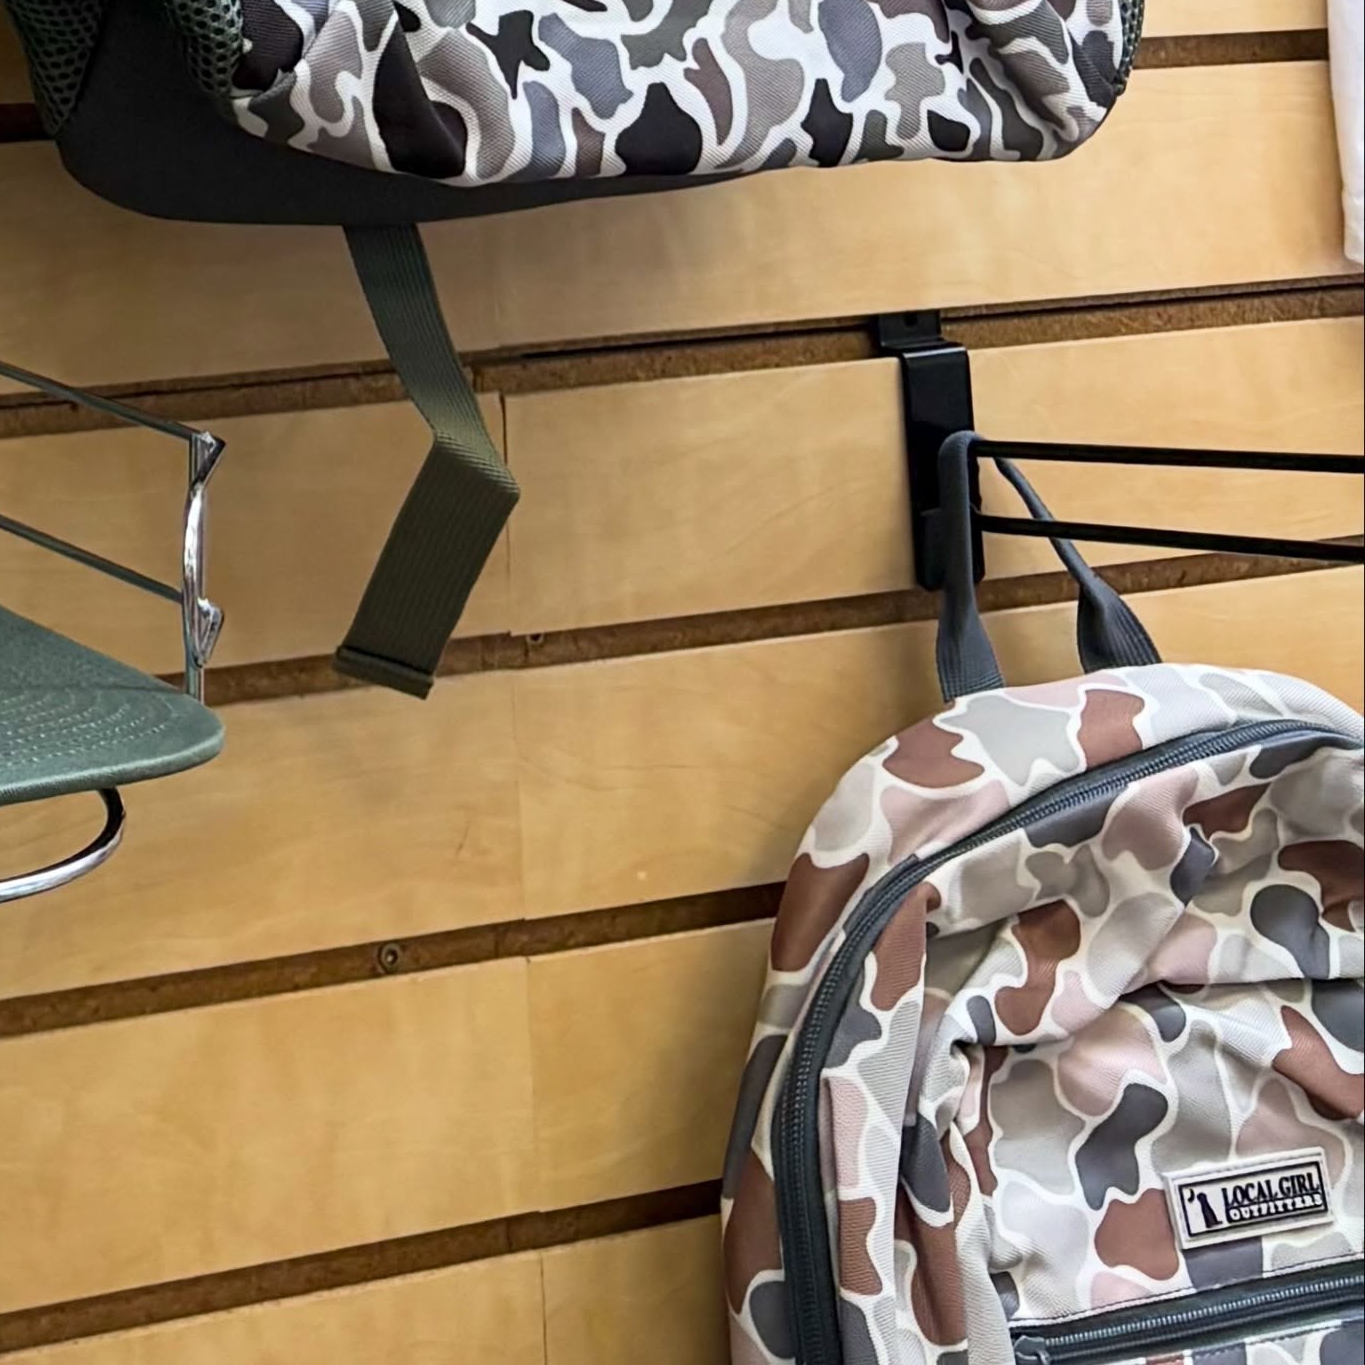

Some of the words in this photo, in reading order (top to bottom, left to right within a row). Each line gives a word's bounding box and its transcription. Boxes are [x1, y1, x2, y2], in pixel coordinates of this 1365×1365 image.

[1221, 1180, 1278, 1207] LOCAL
[1279, 1172, 1319, 1196] GIRL
[1228, 1194, 1323, 1221] OUTFITTERS
